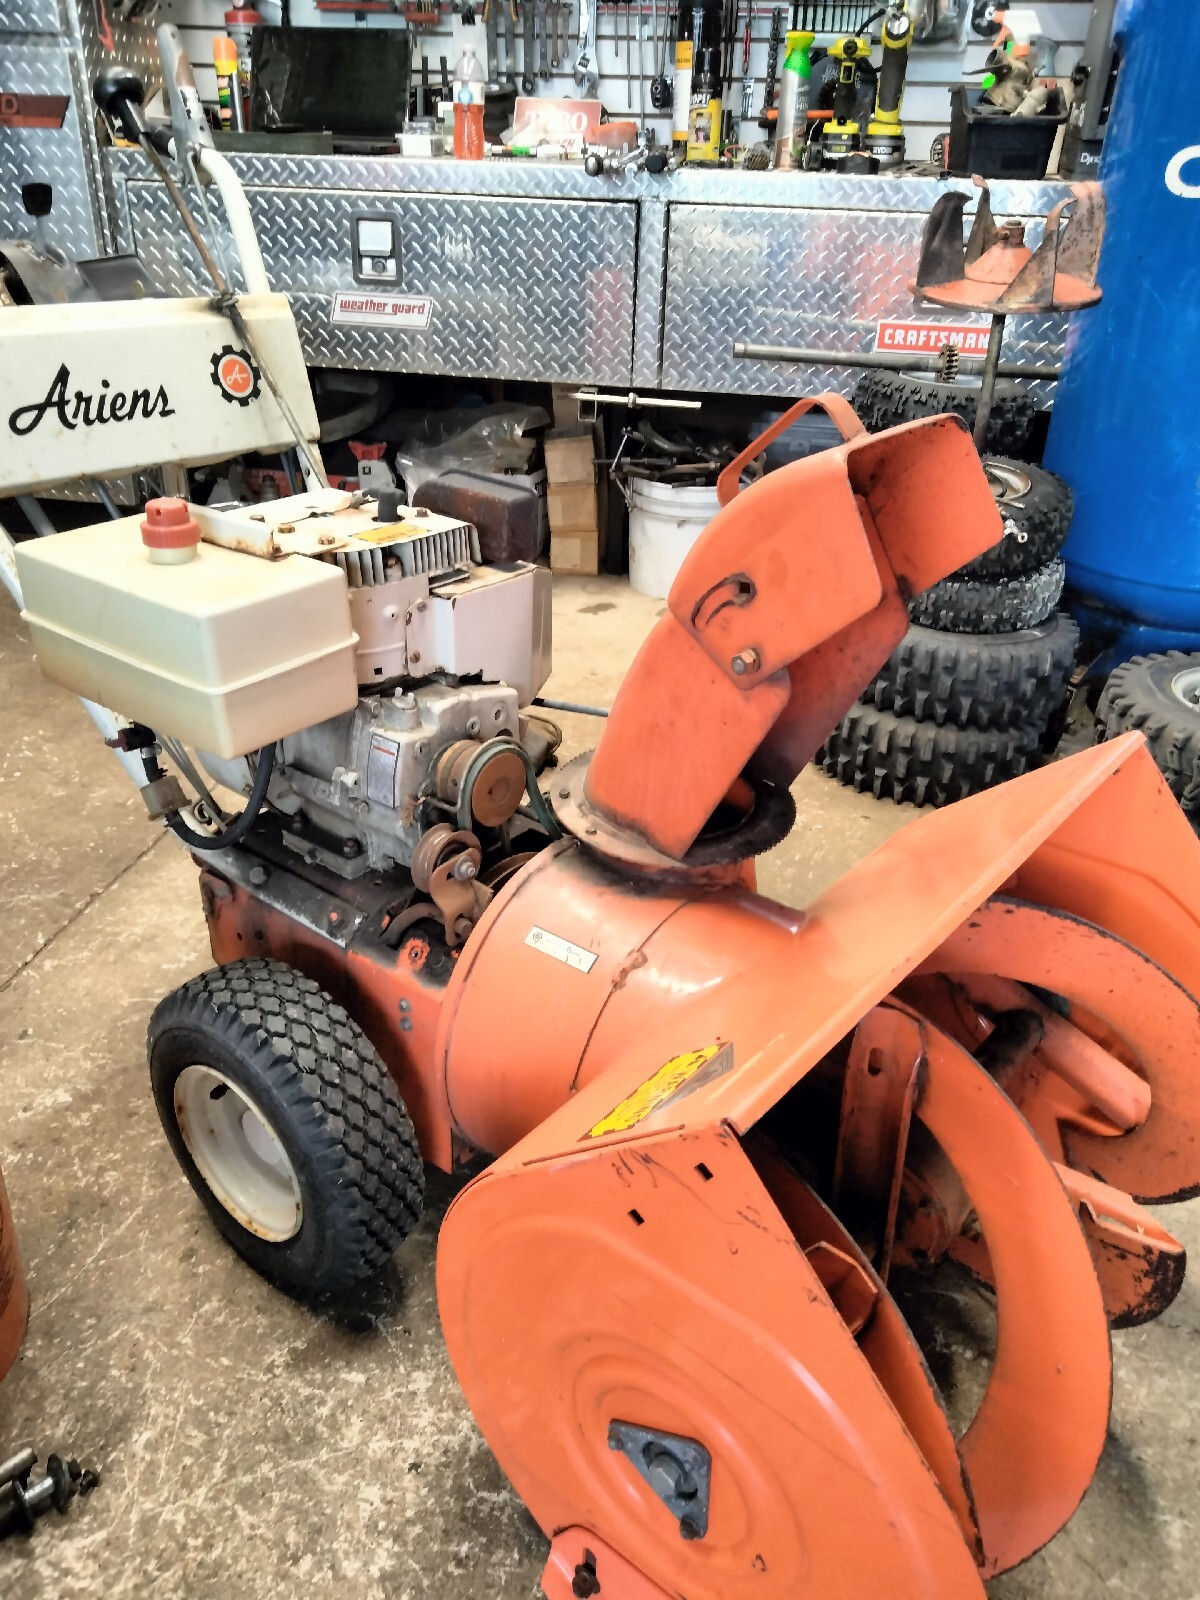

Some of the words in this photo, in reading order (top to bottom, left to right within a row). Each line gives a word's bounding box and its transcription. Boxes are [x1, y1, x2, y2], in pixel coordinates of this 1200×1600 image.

[525, 110, 588, 134] TRO
[340, 299, 388, 312] weather
[391, 303, 426, 315] guard
[883, 327, 991, 350] CRAFTSMAN
[8, 362, 176, 436] Ariens
